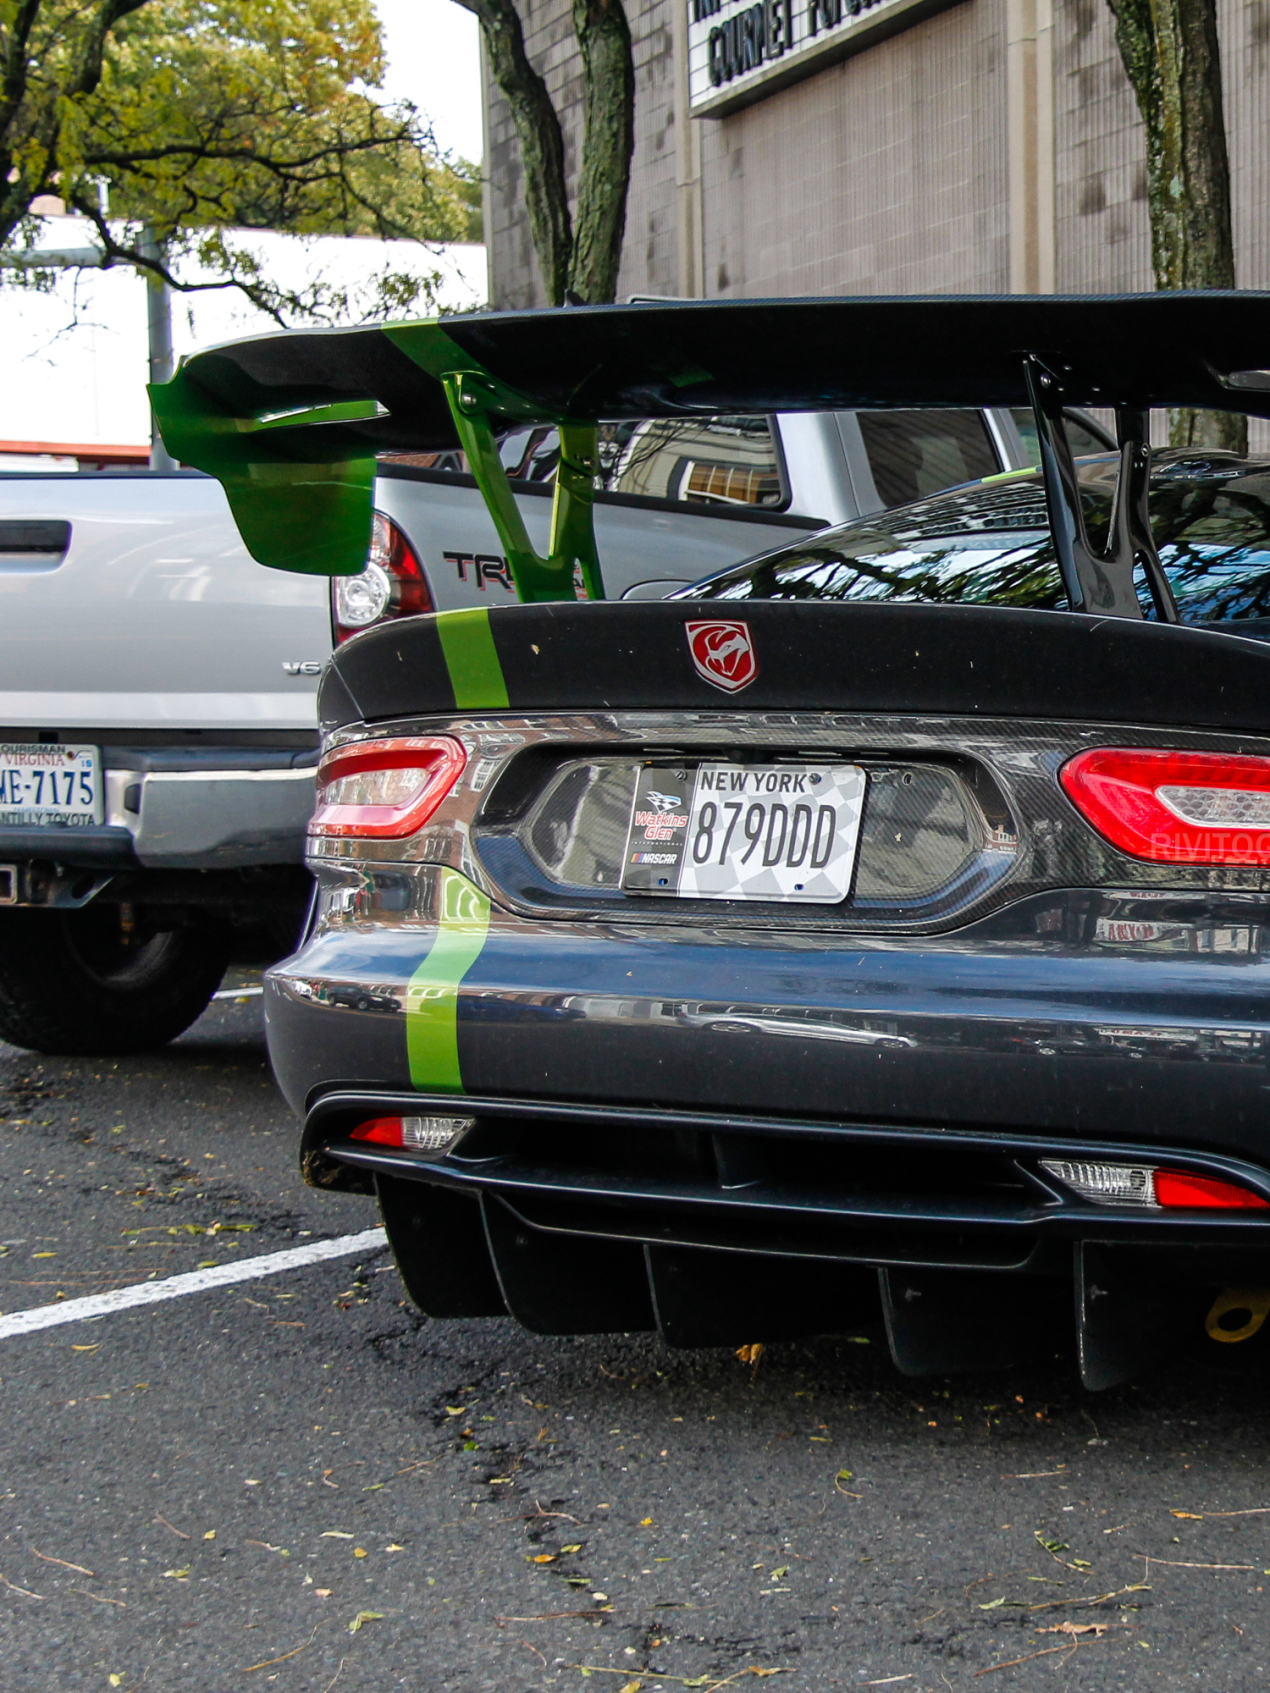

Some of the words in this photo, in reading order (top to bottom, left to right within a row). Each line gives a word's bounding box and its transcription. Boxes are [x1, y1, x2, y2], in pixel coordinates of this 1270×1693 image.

[281, 661, 321, 675] V6
[1, 744, 66, 754] OURISMAN
[5, 753, 66, 766] VIRGINIA
[701, 771, 749, 792] NEW
[753, 773, 807, 793] YORK
[46, 813, 96, 826] TOYOTA
[635, 811, 689, 827] Watkins
[644, 826, 674, 840] Glen
[692, 801, 837, 869] 879DDD
[641, 853, 678, 865] NASCAR
